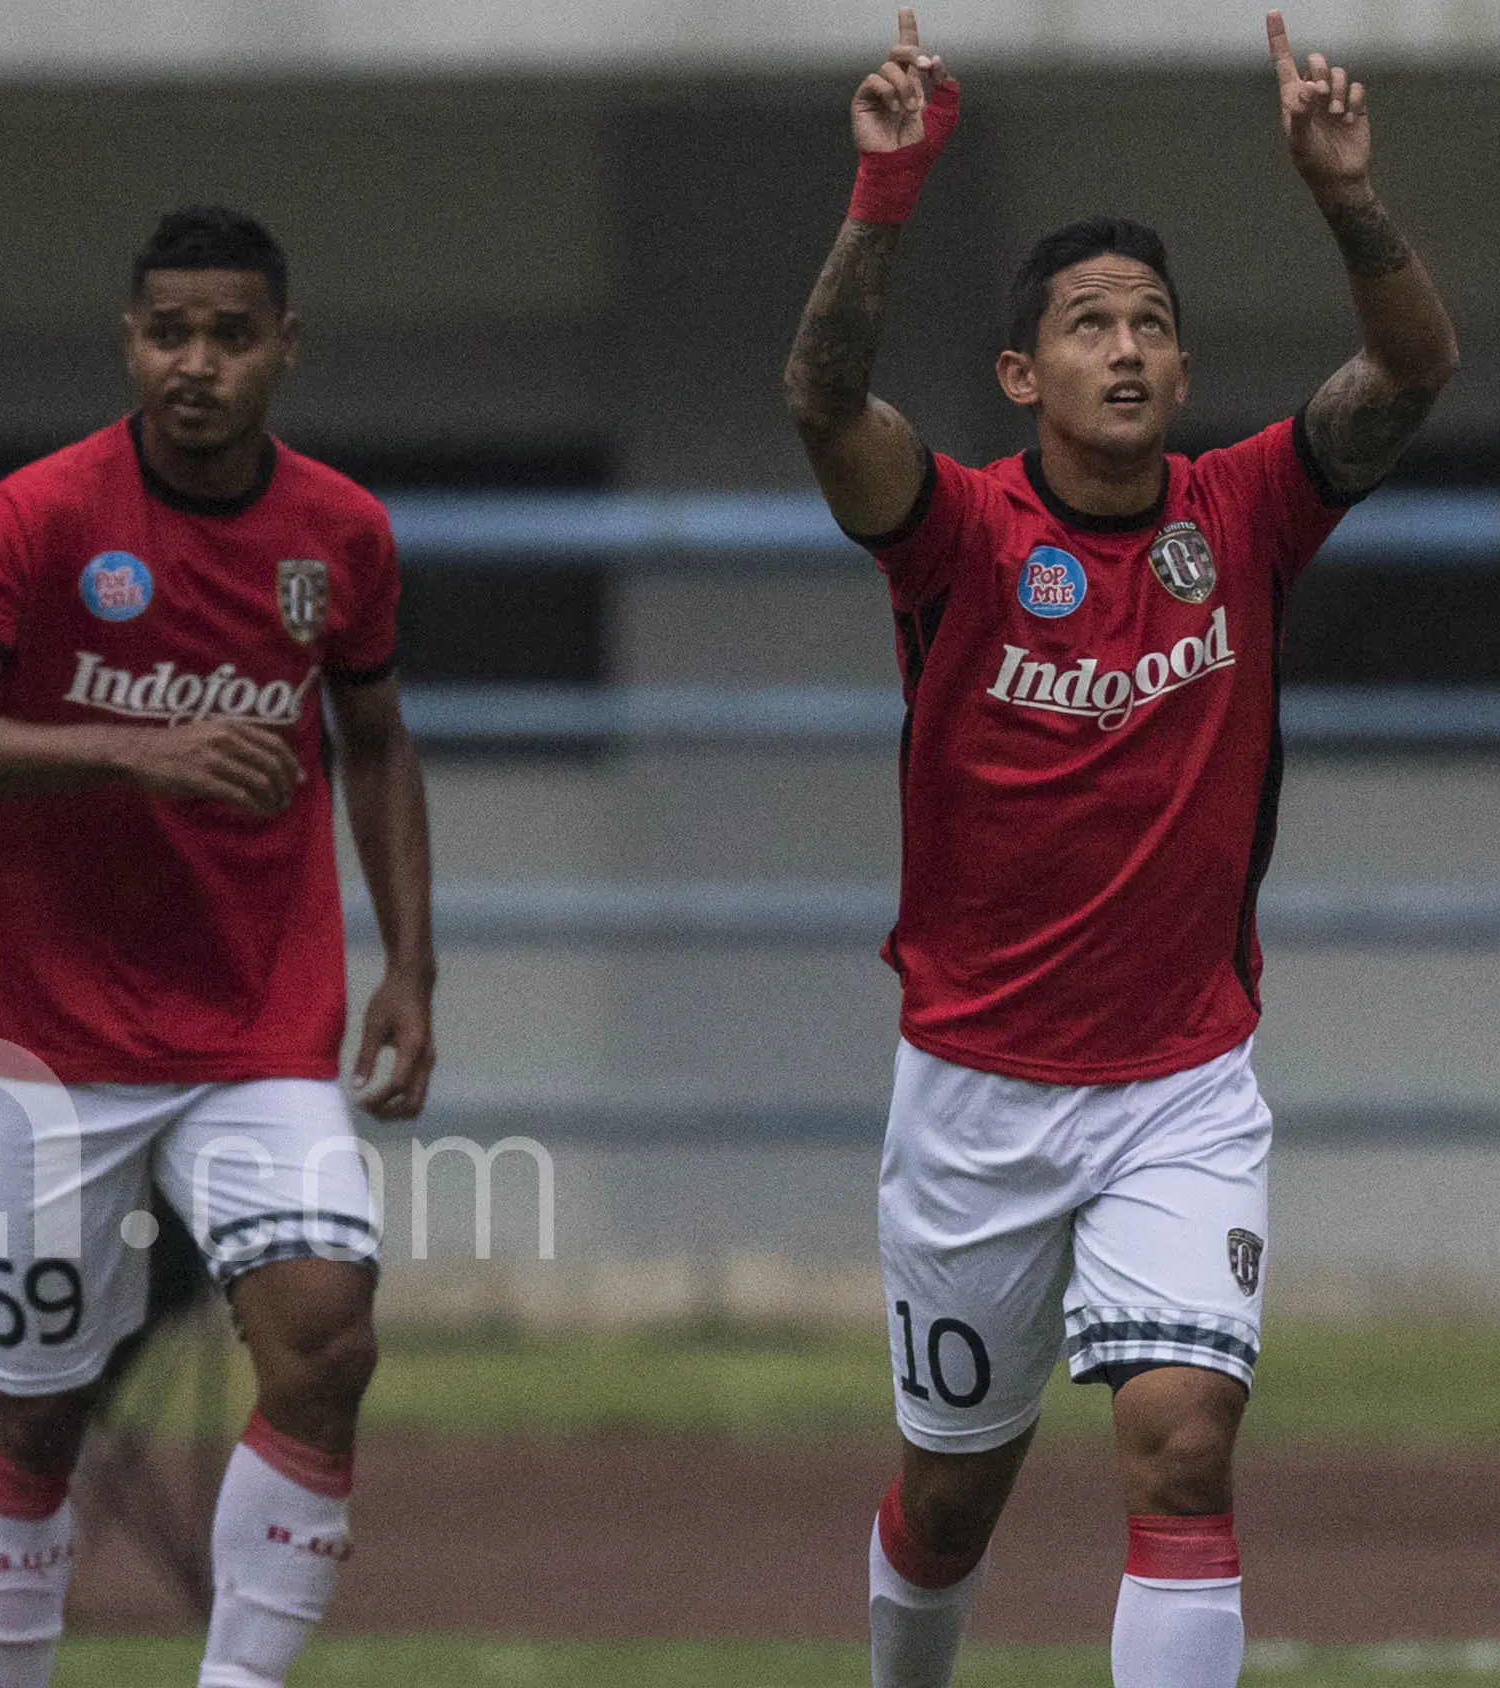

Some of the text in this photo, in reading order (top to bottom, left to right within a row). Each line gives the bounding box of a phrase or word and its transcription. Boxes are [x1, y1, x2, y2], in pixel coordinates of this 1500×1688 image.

[1026, 562, 1067, 586] POP
[1029, 581, 1075, 605] MIE
[895, 1300, 991, 1409] 10
